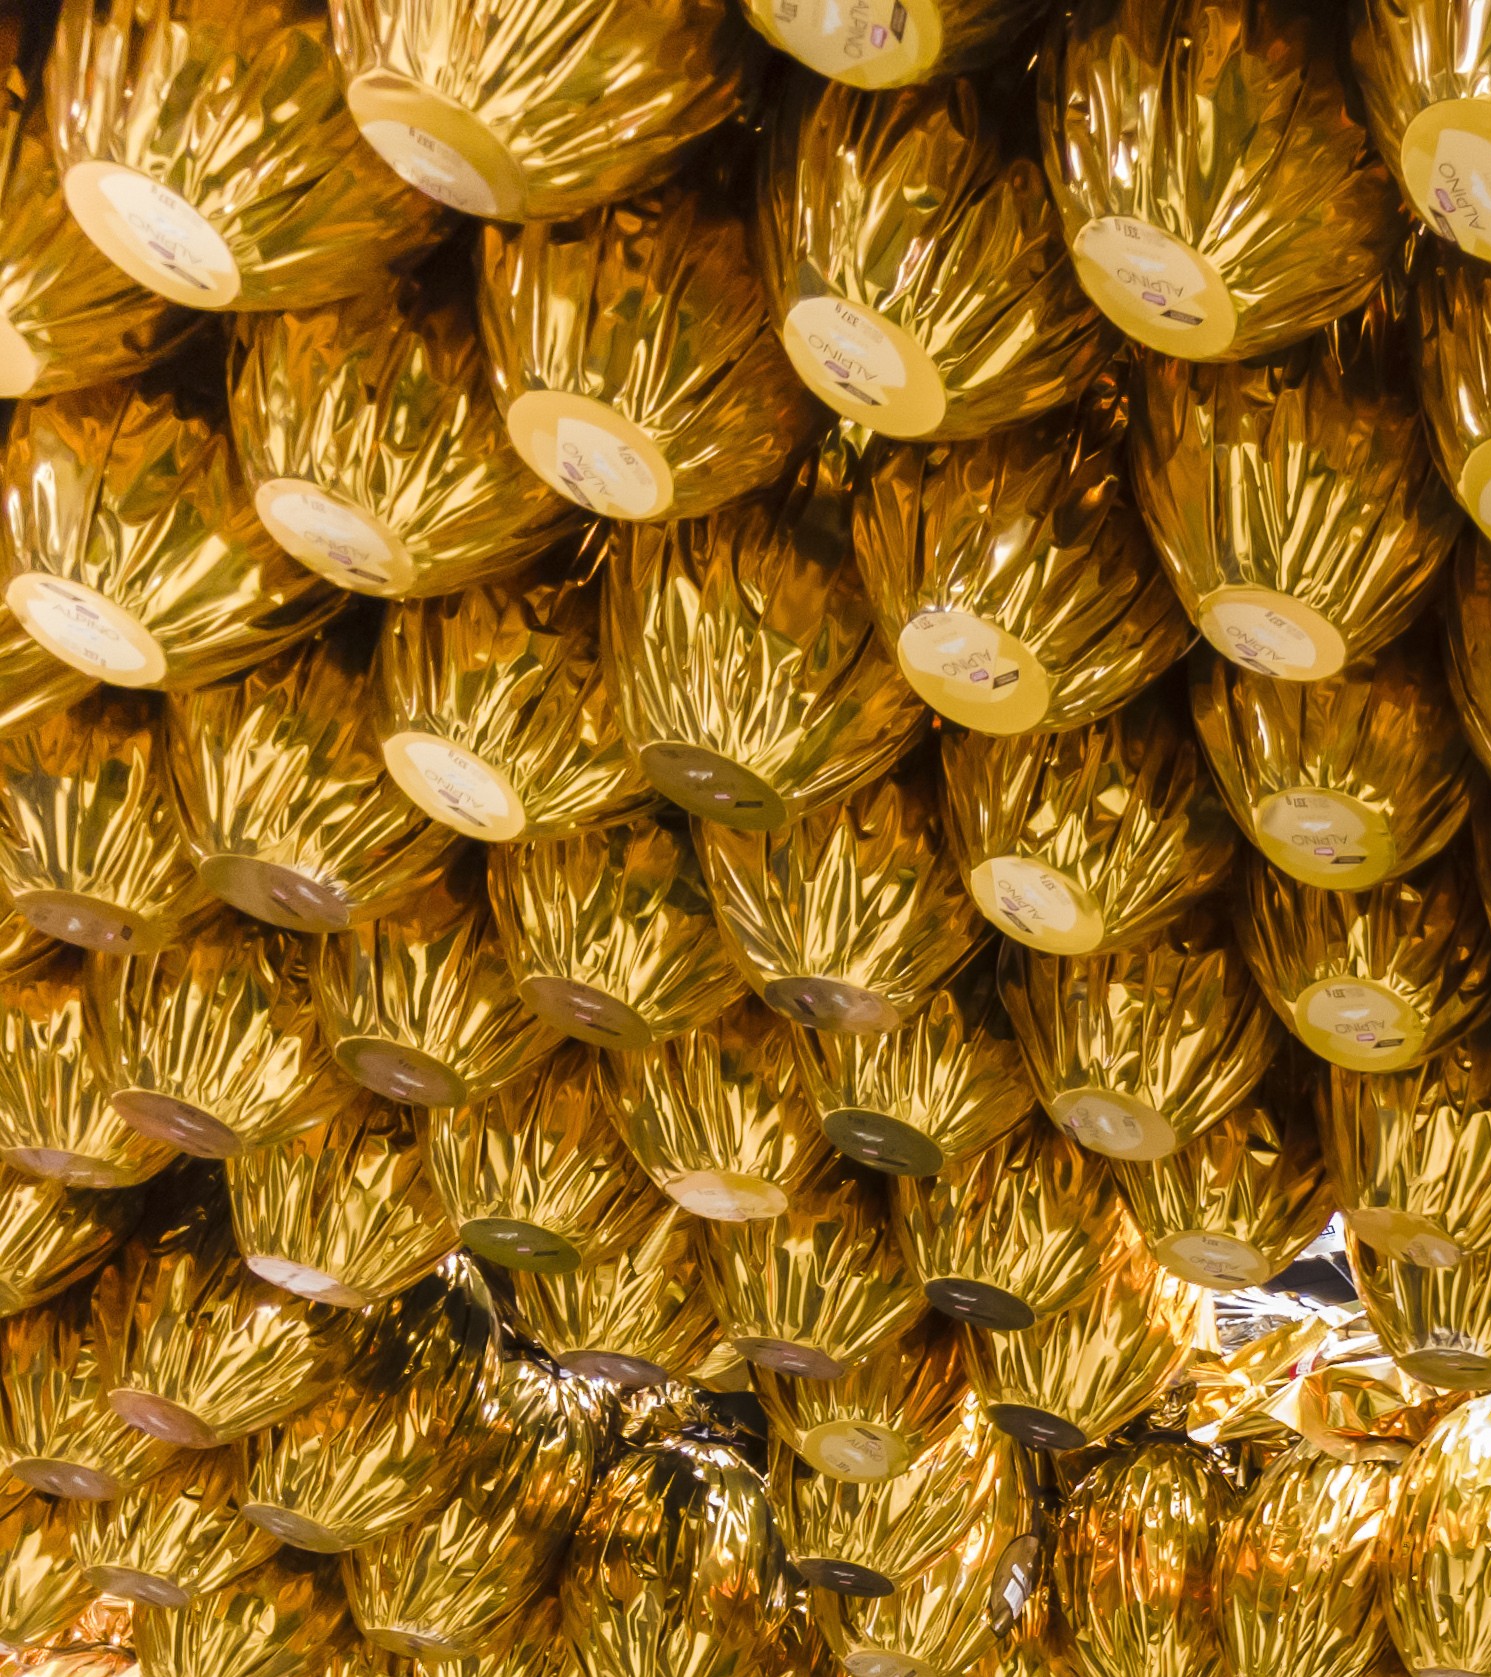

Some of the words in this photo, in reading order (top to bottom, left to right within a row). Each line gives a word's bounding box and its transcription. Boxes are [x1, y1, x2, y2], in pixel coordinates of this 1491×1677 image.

[1439, 162, 1486, 231] ALPINO
[1116, 267, 1183, 298] ALPINO
[806, 333, 877, 381] ALPINO
[942, 649, 991, 675] ALPINO
[1225, 624, 1286, 663] ALPINO
